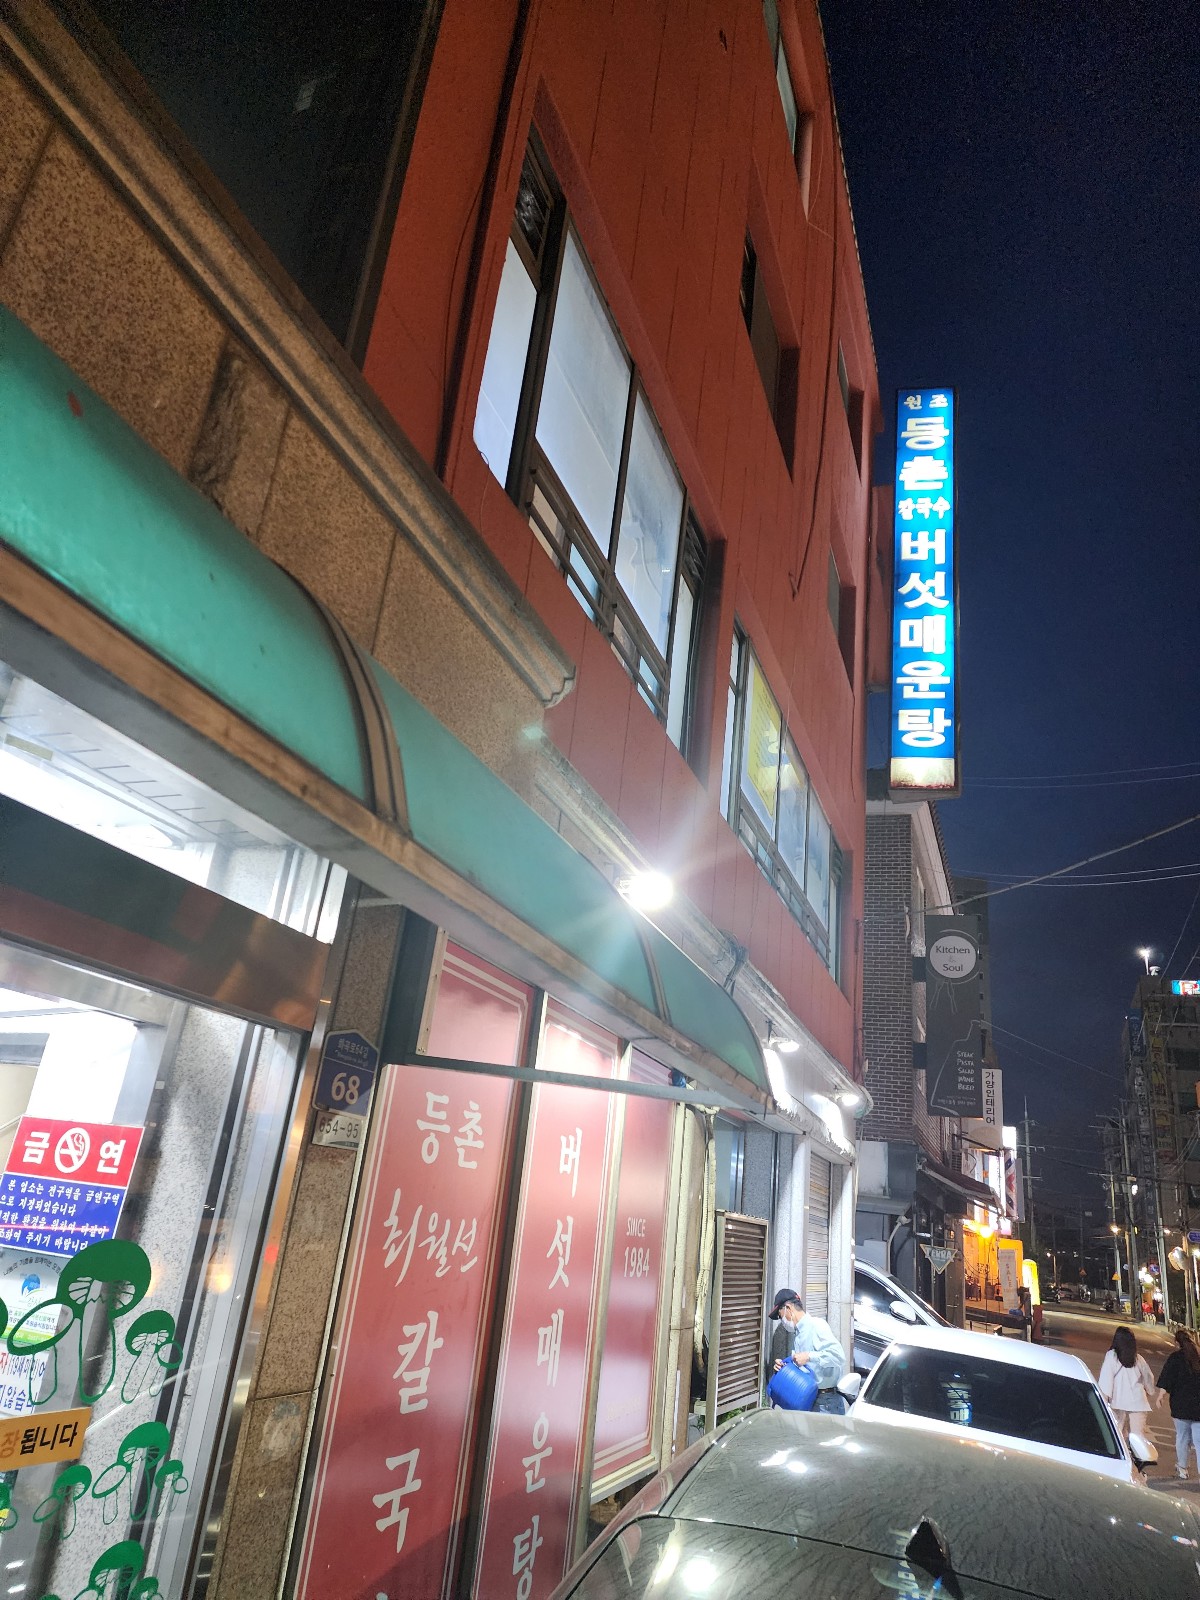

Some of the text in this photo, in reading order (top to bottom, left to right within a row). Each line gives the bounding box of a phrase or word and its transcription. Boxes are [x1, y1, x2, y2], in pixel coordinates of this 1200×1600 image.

[896, 529, 952, 748] 버섯매운탕
[935, 945, 971, 954] Kitchen
[942, 963, 964, 972] Soul
[331, 1072, 360, 1105] 68
[985, 1071, 995, 1126] 가양인테리어
[319, 1117, 359, 1139] 654-95
[416, 1091, 484, 1169] 등촌
[23, 1131, 126, 1174] 금 연
[8, 1179, 120, 1206] 본 업소는 전구역을 금연구역
[18, 1197, 76, 1217] 지정되었습니다
[22, 1214, 47, 1230] 환경을
[626, 1217, 646, 1238] SINCE
[25, 1232, 51, 1247] 주시기
[624, 1246, 650, 1279] 1984
